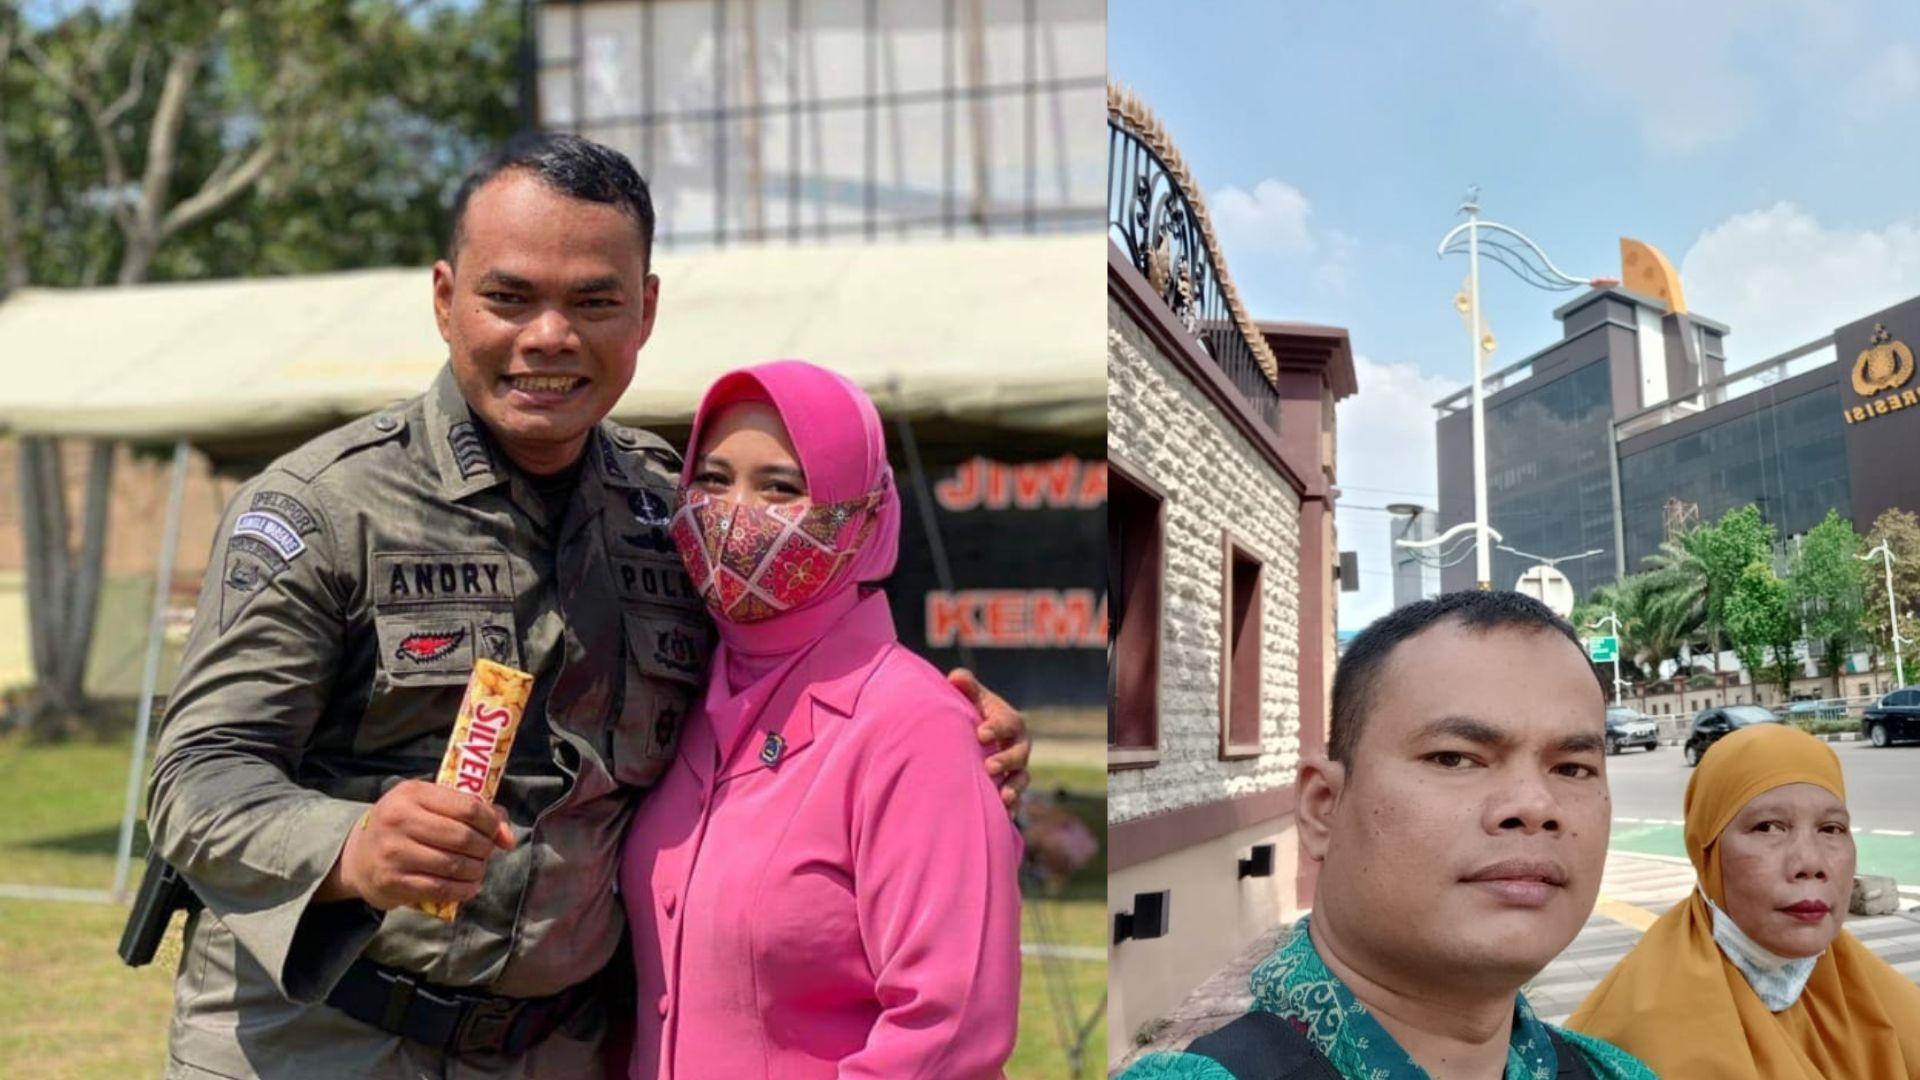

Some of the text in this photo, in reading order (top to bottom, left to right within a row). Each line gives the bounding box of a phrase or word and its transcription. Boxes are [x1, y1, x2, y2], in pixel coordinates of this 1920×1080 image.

[389, 563, 500, 595] ANDRY
[926, 589, 1107, 648] KEM
[456, 702, 510, 800] SILVER
